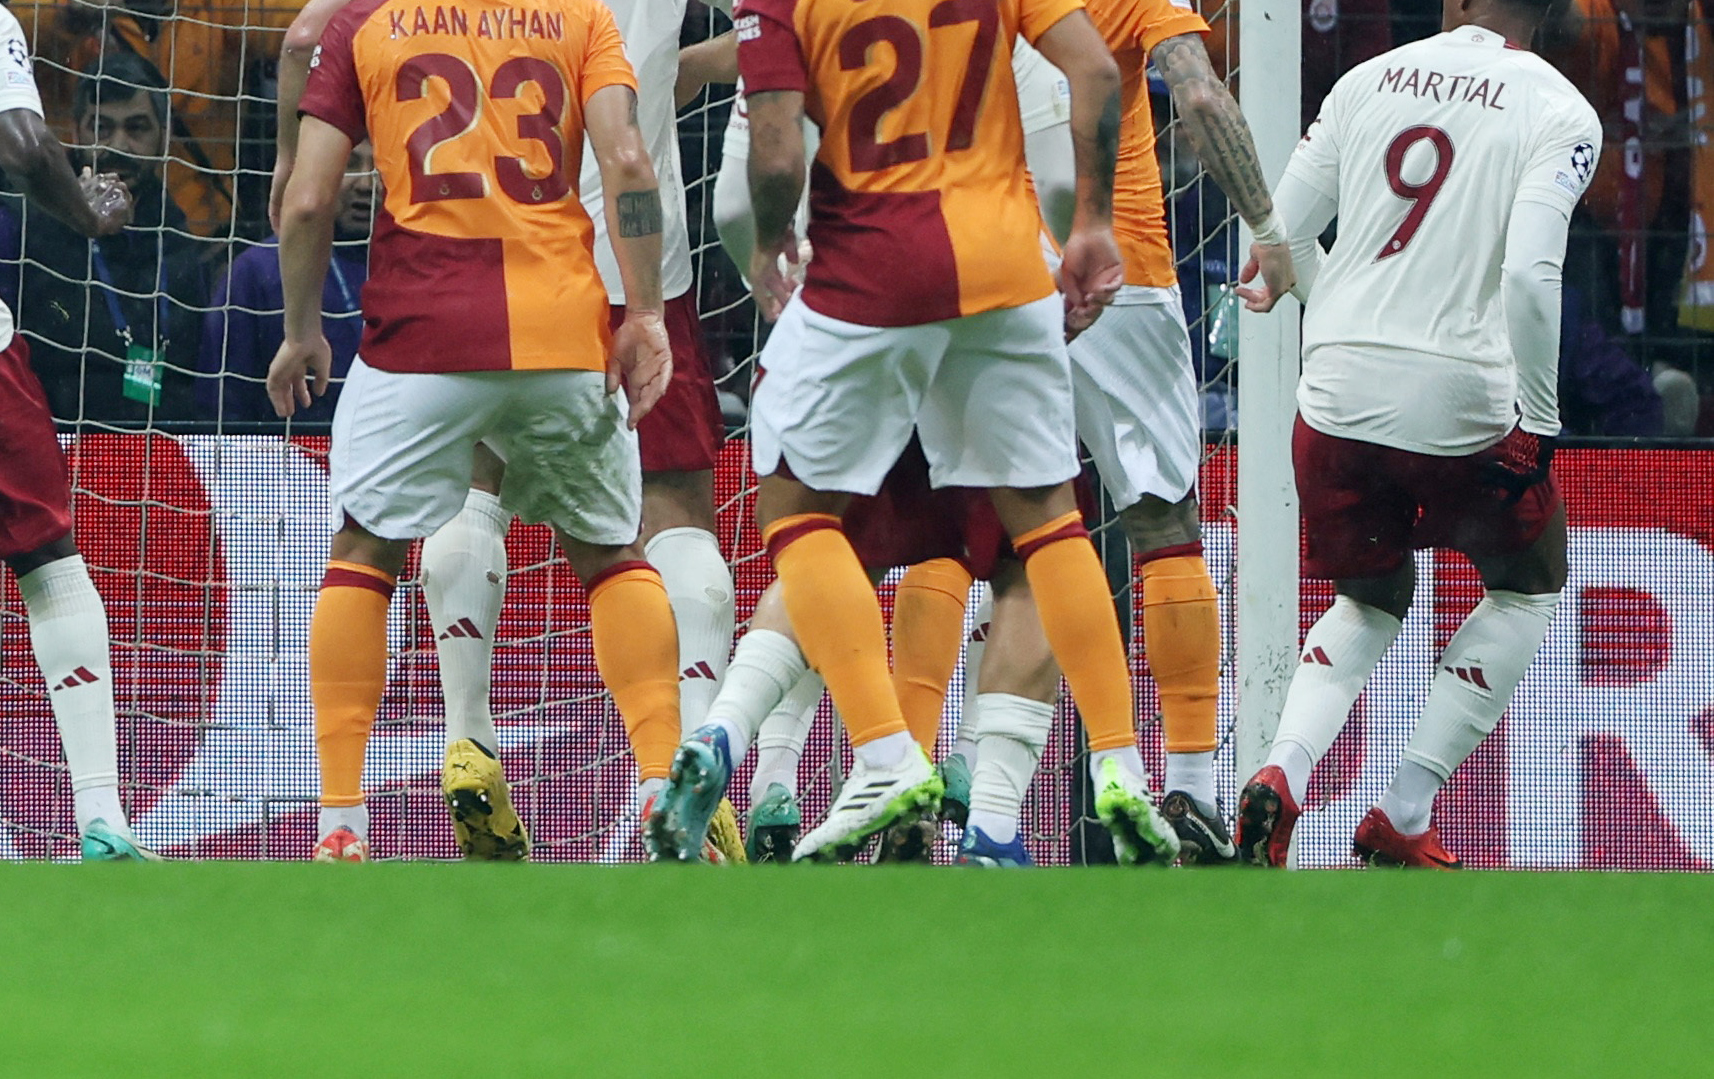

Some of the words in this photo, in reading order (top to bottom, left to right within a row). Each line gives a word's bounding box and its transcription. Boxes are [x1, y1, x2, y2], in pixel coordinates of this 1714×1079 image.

[389, 5, 468, 39] KAAN
[477, 7, 564, 42] AYHAN
[395, 52, 574, 206] 23
[1377, 66, 1507, 111] MARTIAL
[1370, 123, 1456, 265] 9
